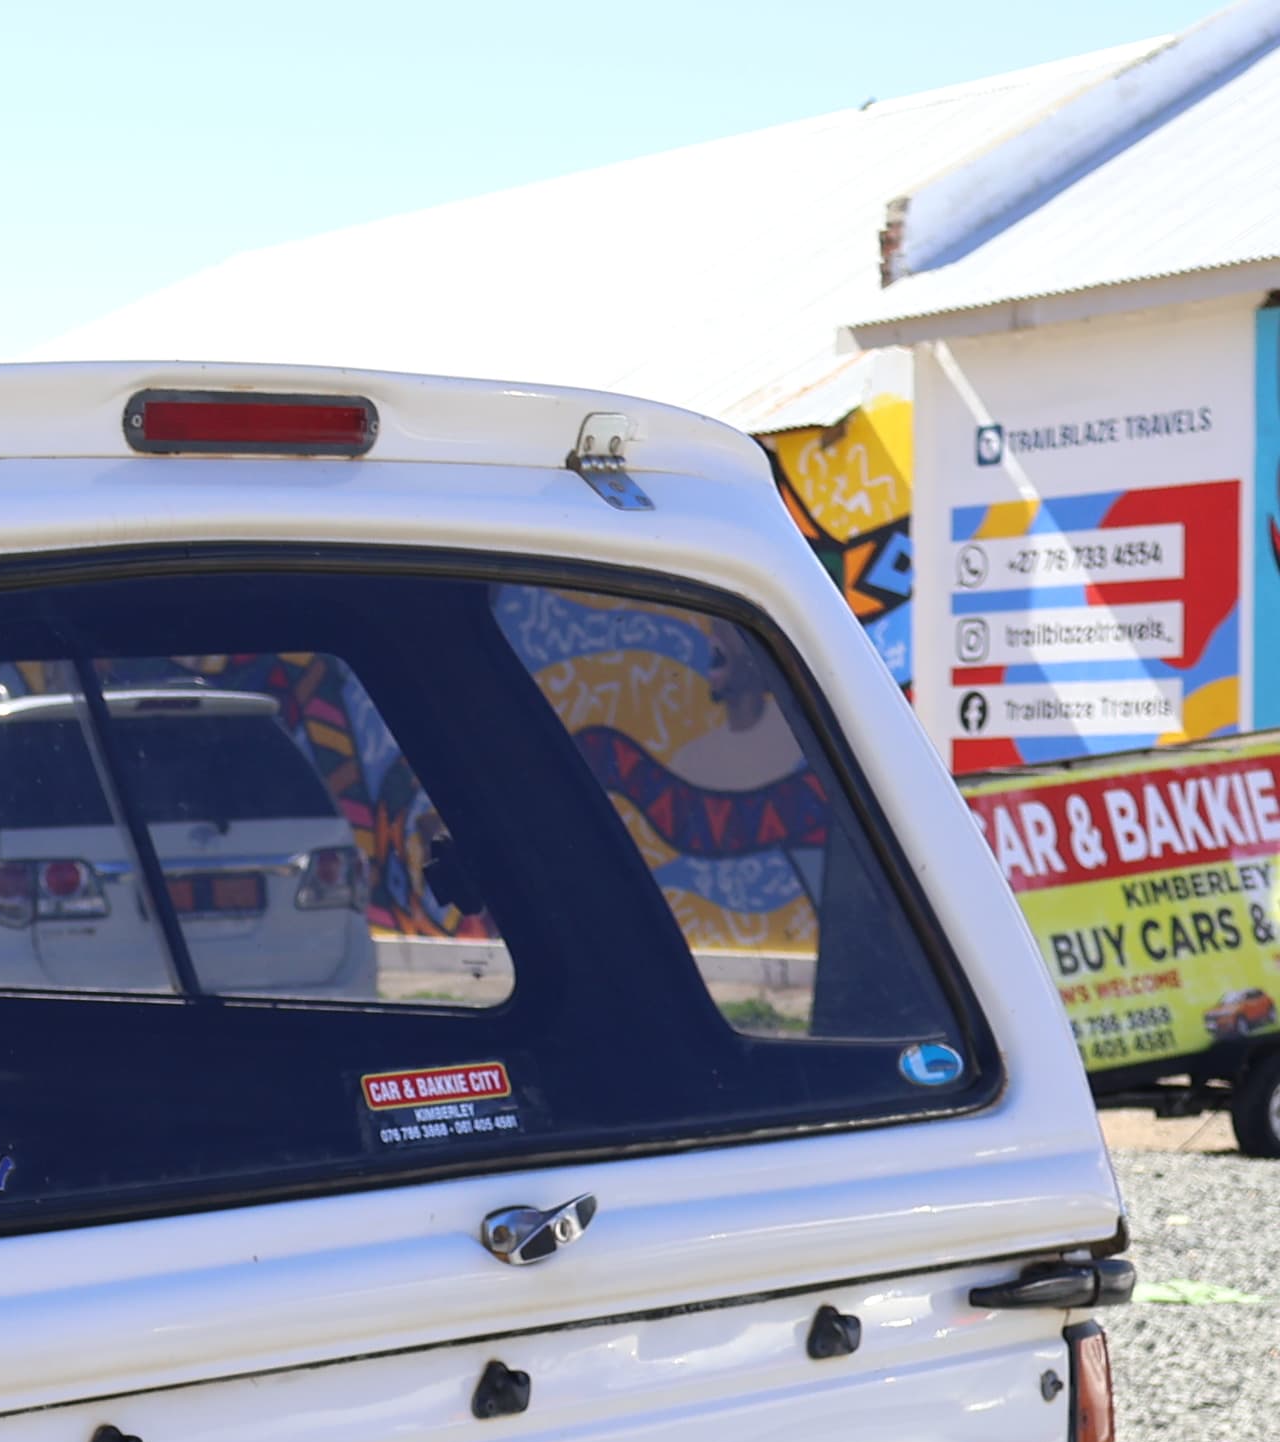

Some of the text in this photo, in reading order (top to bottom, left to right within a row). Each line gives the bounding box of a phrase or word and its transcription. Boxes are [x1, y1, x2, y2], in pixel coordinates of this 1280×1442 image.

[1008, 407, 1213, 454] TRAILBLAZE TRAVELS
[1005, 695, 1174, 721] Trailblaze Travels
[1066, 795, 1108, 870] &
[1104, 768, 1280, 863] BAKKIE
[1121, 862, 1272, 909] KIMBERLEY
[1050, 903, 1275, 976] BUY CARS &
[1095, 969, 1182, 999] WELCOME
[369, 1069, 502, 1103] CAR & BAKKIE CITY
[413, 1102, 476, 1122] KIMBERLEY
